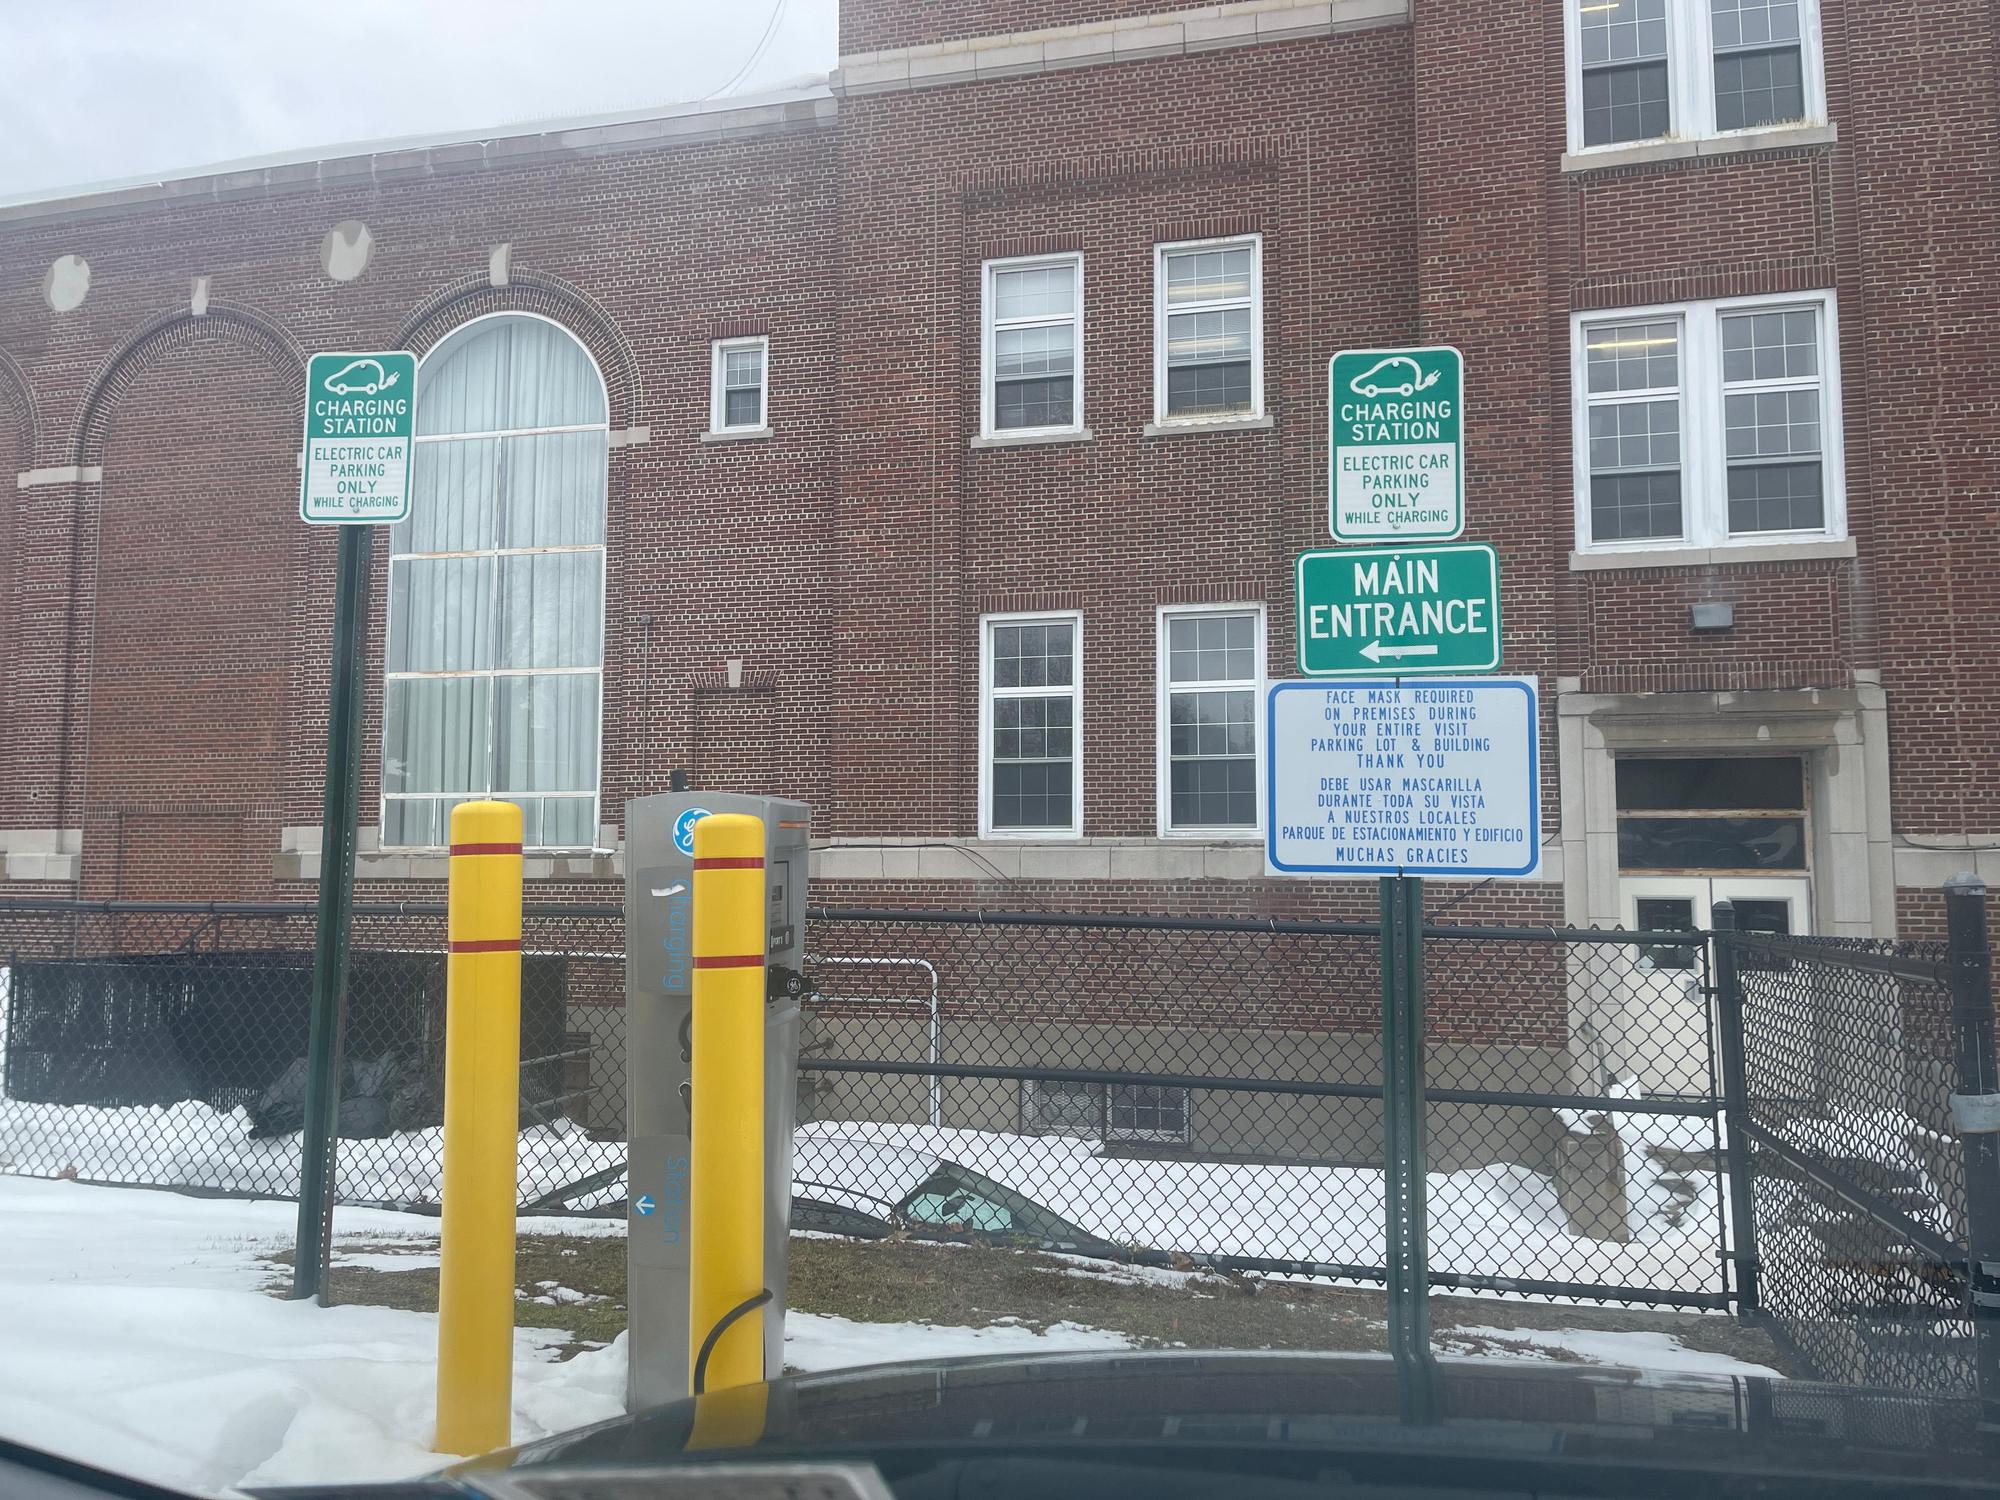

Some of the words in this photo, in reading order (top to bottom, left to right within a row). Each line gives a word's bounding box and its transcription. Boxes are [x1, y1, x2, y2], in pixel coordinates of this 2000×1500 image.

[315, 399, 407, 416] CHARGING
[1341, 400, 1451, 421] CHARGING
[323, 417, 396, 434] STATION
[1352, 421, 1440, 441] STATION
[315, 447, 374, 460] ELECTRIC
[378, 446, 402, 460] CAR
[330, 463, 385, 477] PARKING
[1343, 455, 1414, 471] ELECTRIC
[1419, 454, 1449, 469] CAR
[337, 480, 377, 494] ONLY
[1363, 473, 1429, 489] PARKING
[314, 497, 344, 508] WHILE
[349, 496, 399, 508] CHARGING
[1372, 493, 1420, 508] ONLY
[1345, 511, 1381, 524] WHILE
[1387, 509, 1448, 524] CHARGING
[1354, 559, 1439, 596] MAIN
[1310, 598, 1487, 639] ENTRANCE
[1327, 691, 1355, 704] FACE
[1368, 691, 1401, 704] MASK
[1415, 690, 1474, 703] REQUIRED
[1325, 707, 1340, 720] ON
[1353, 707, 1416, 720] PREMISES
[1429, 707, 1476, 720] DURING
[1334, 723, 1367, 736] YOUR
[1377, 723, 1421, 736] ENTIRE
[1435, 723, 1468, 736] VISIT
[1311, 738, 1363, 751] PARKING
[1376, 738, 1397, 751] LOT
[1412, 738, 1421, 751] &
[1434, 738, 1490, 751] BUILDING
[1357, 754, 1404, 768] THANK
[1417, 754, 1444, 768] YOU
[1321, 778, 1349, 791] DEBE
[1360, 778, 1391, 791] USAR
[1403, 778, 1482, 791] MASCARILLA
[1318, 794, 1372, 807] DURANTE
[1383, 794, 1413, 808] TODA
[1425, 795, 1439, 808] SU
[1451, 795, 1485, 808] VISTA
[1328, 810, 1335, 823] A
[1345, 810, 1409, 824] NUESTROS
[1420, 811, 1476, 824] LOCALES
[1282, 826, 1325, 840] PARQUE
[1332, 827, 1346, 840] DE
[1353, 827, 1456, 841] ESTACIONAMIENTO
[1463, 828, 1470, 840] Y
[1475, 828, 1523, 842] EDIFICIO
[1336, 847, 1394, 862] MUCHAS
[1407, 848, 1468, 863] GRACIES
[663, 879, 692, 991] Charging
[662, 1154, 690, 1245] Station
